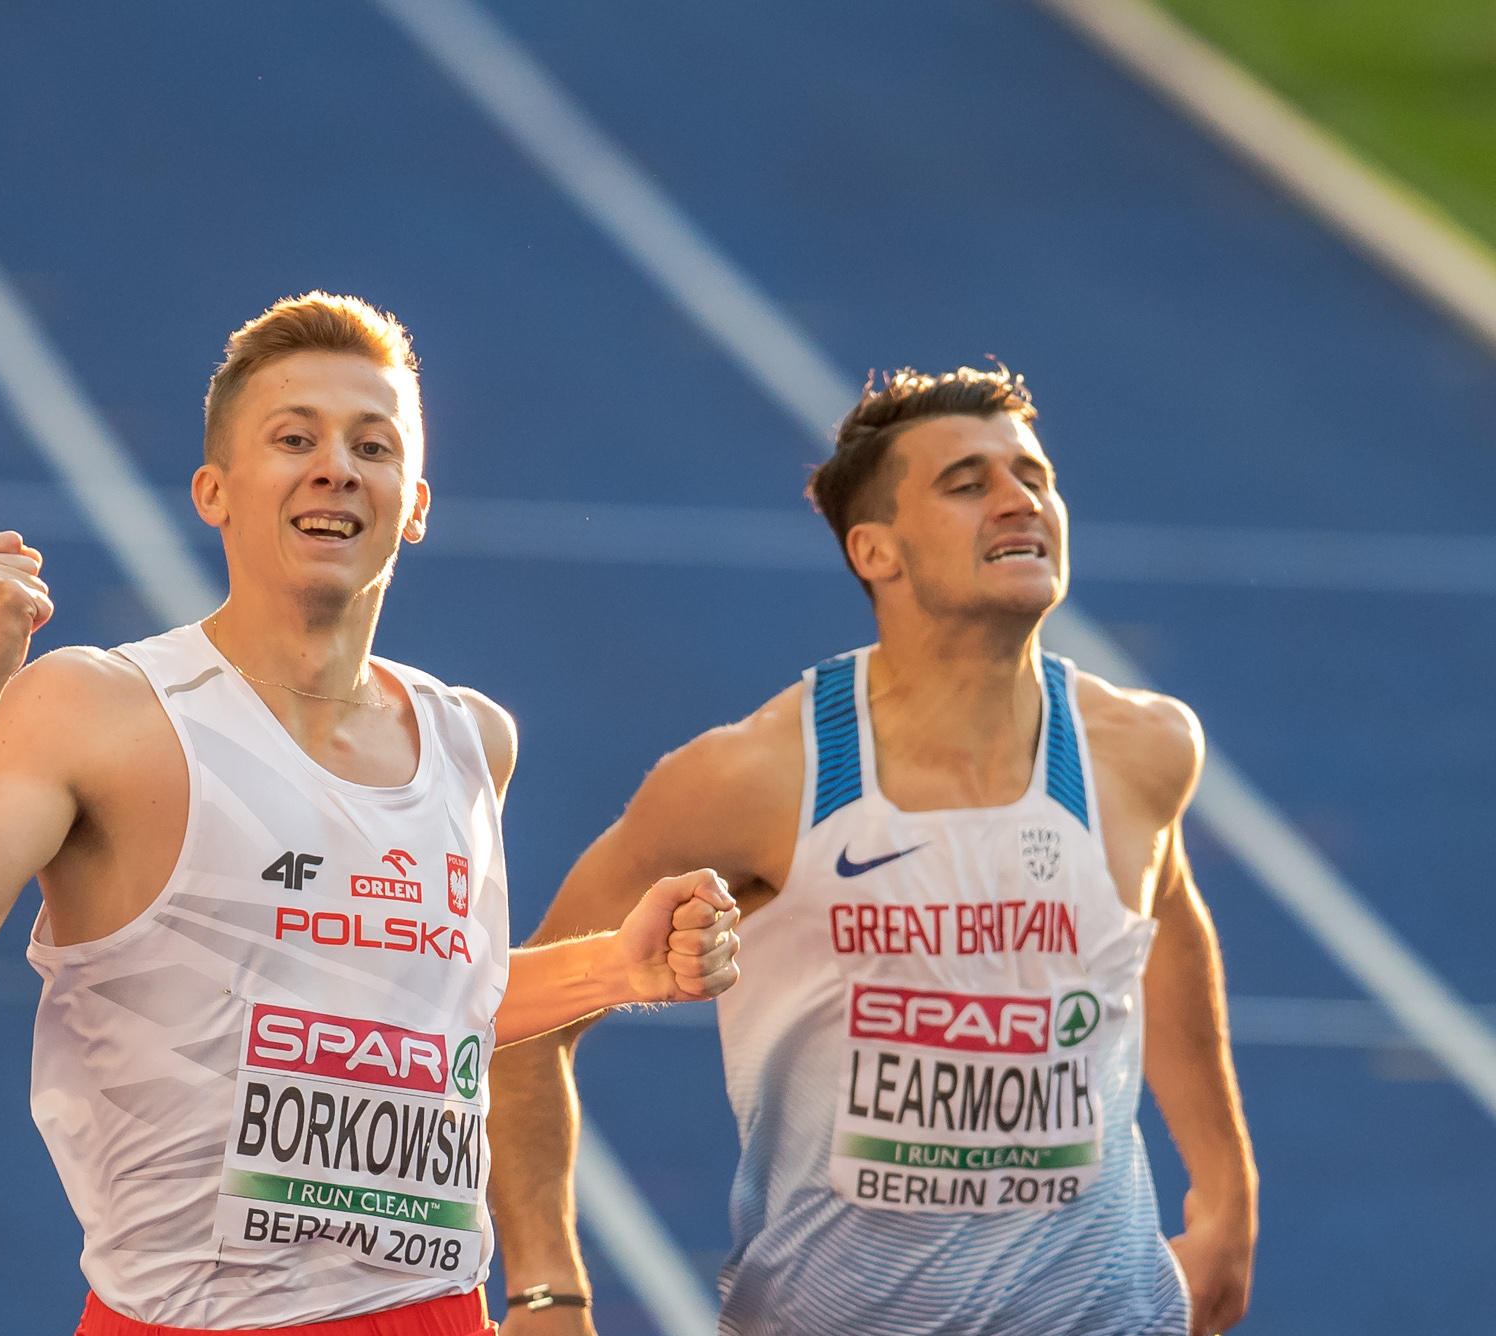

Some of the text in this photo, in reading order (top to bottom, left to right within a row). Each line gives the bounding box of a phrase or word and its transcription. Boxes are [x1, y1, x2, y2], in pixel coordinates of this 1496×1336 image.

[354, 879, 420, 900] ORLEN
[275, 907, 473, 964] POLSKA
[830, 900, 1079, 956] GREAT BRITAIN
[855, 992, 1047, 1049] SPAR
[254, 1014, 443, 1085] SPAR
[847, 1049, 1094, 1133] LEARMONTH
[236, 1080, 481, 1190] BORKOWSKI
[894, 1143, 902, 1162] I
[908, 1145, 960, 1167] RUN
[287, 1182, 294, 1200] I
[301, 1184, 351, 1209] RUN
[856, 1167, 1080, 1207] BERLIN 2018
[243, 1207, 463, 1272] BERLIN 2018
